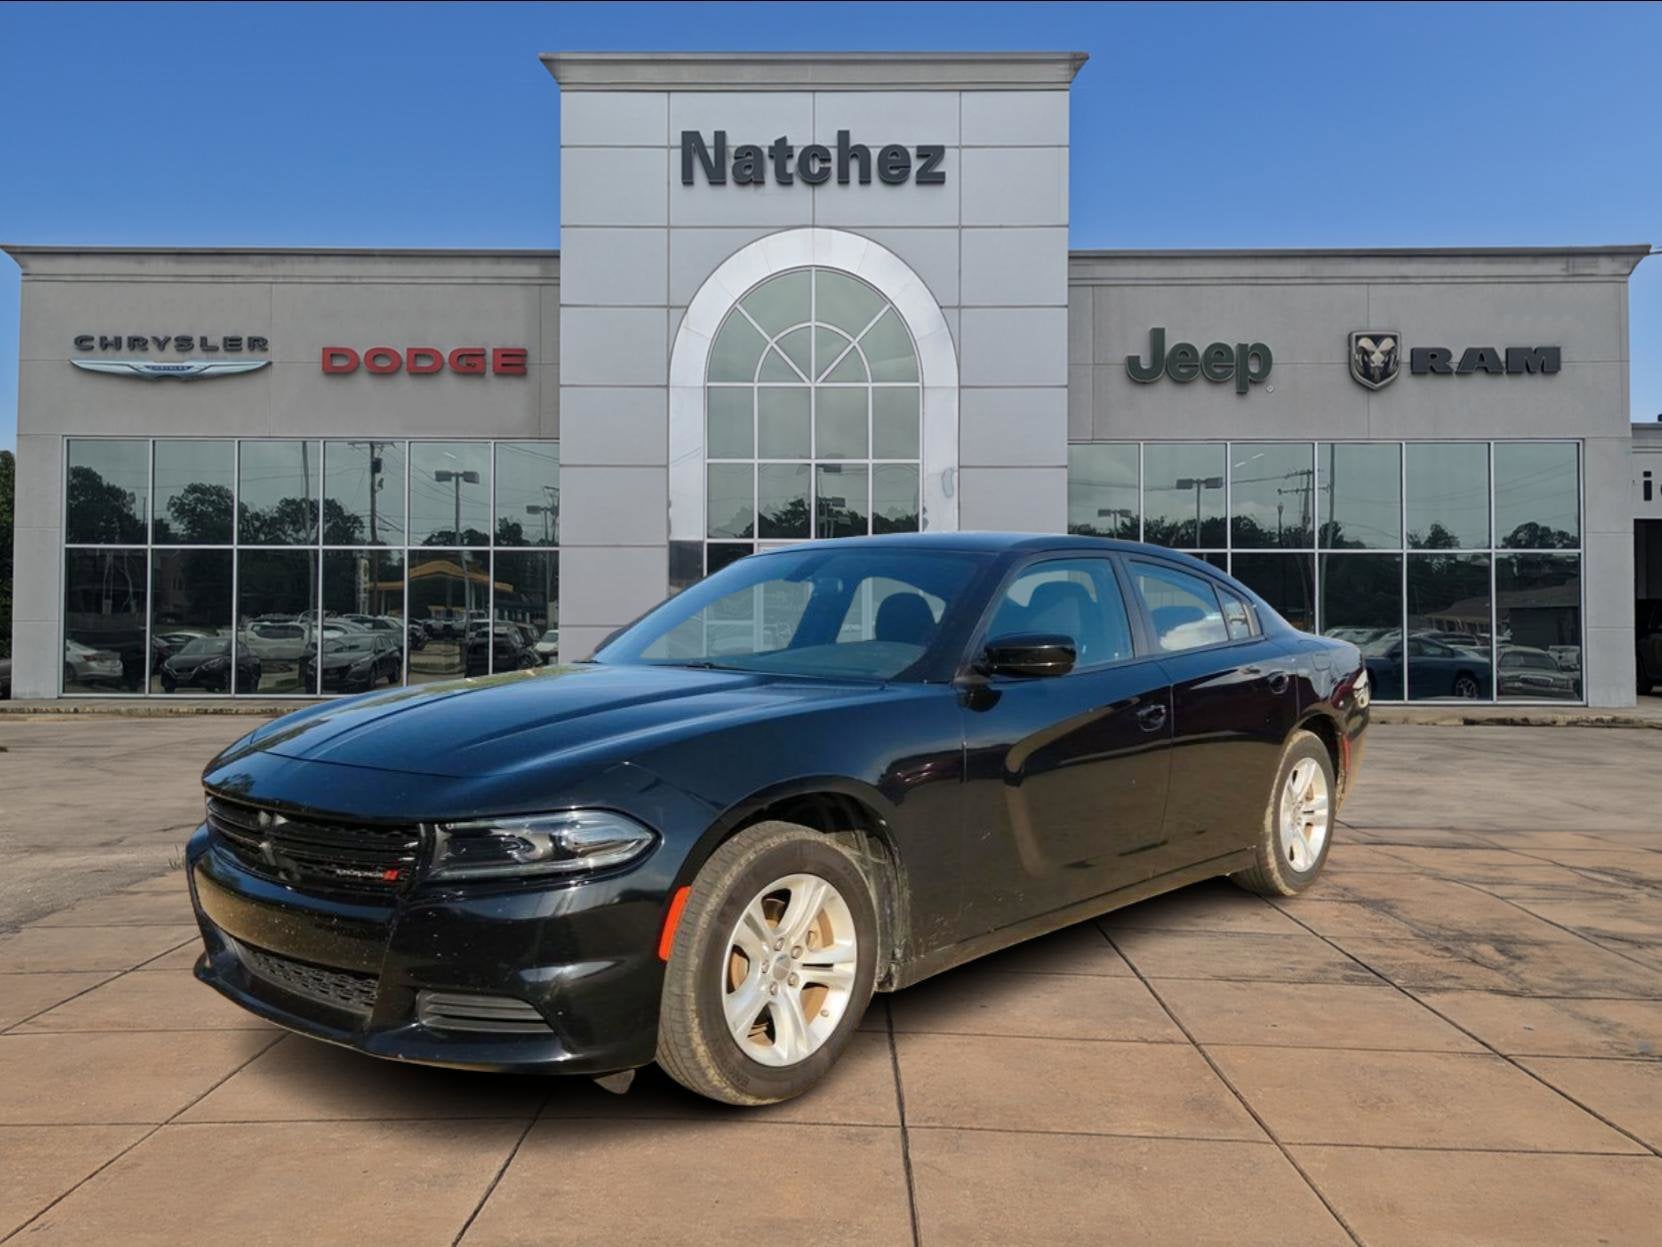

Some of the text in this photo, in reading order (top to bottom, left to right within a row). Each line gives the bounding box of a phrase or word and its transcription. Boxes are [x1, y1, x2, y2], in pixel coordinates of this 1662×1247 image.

[681, 130, 946, 185] Natchez
[74, 335, 269, 352] CHRYSLER
[322, 347, 528, 375] DODGE
[1126, 327, 1273, 394] Jeep
[1410, 347, 1561, 374] RAM
